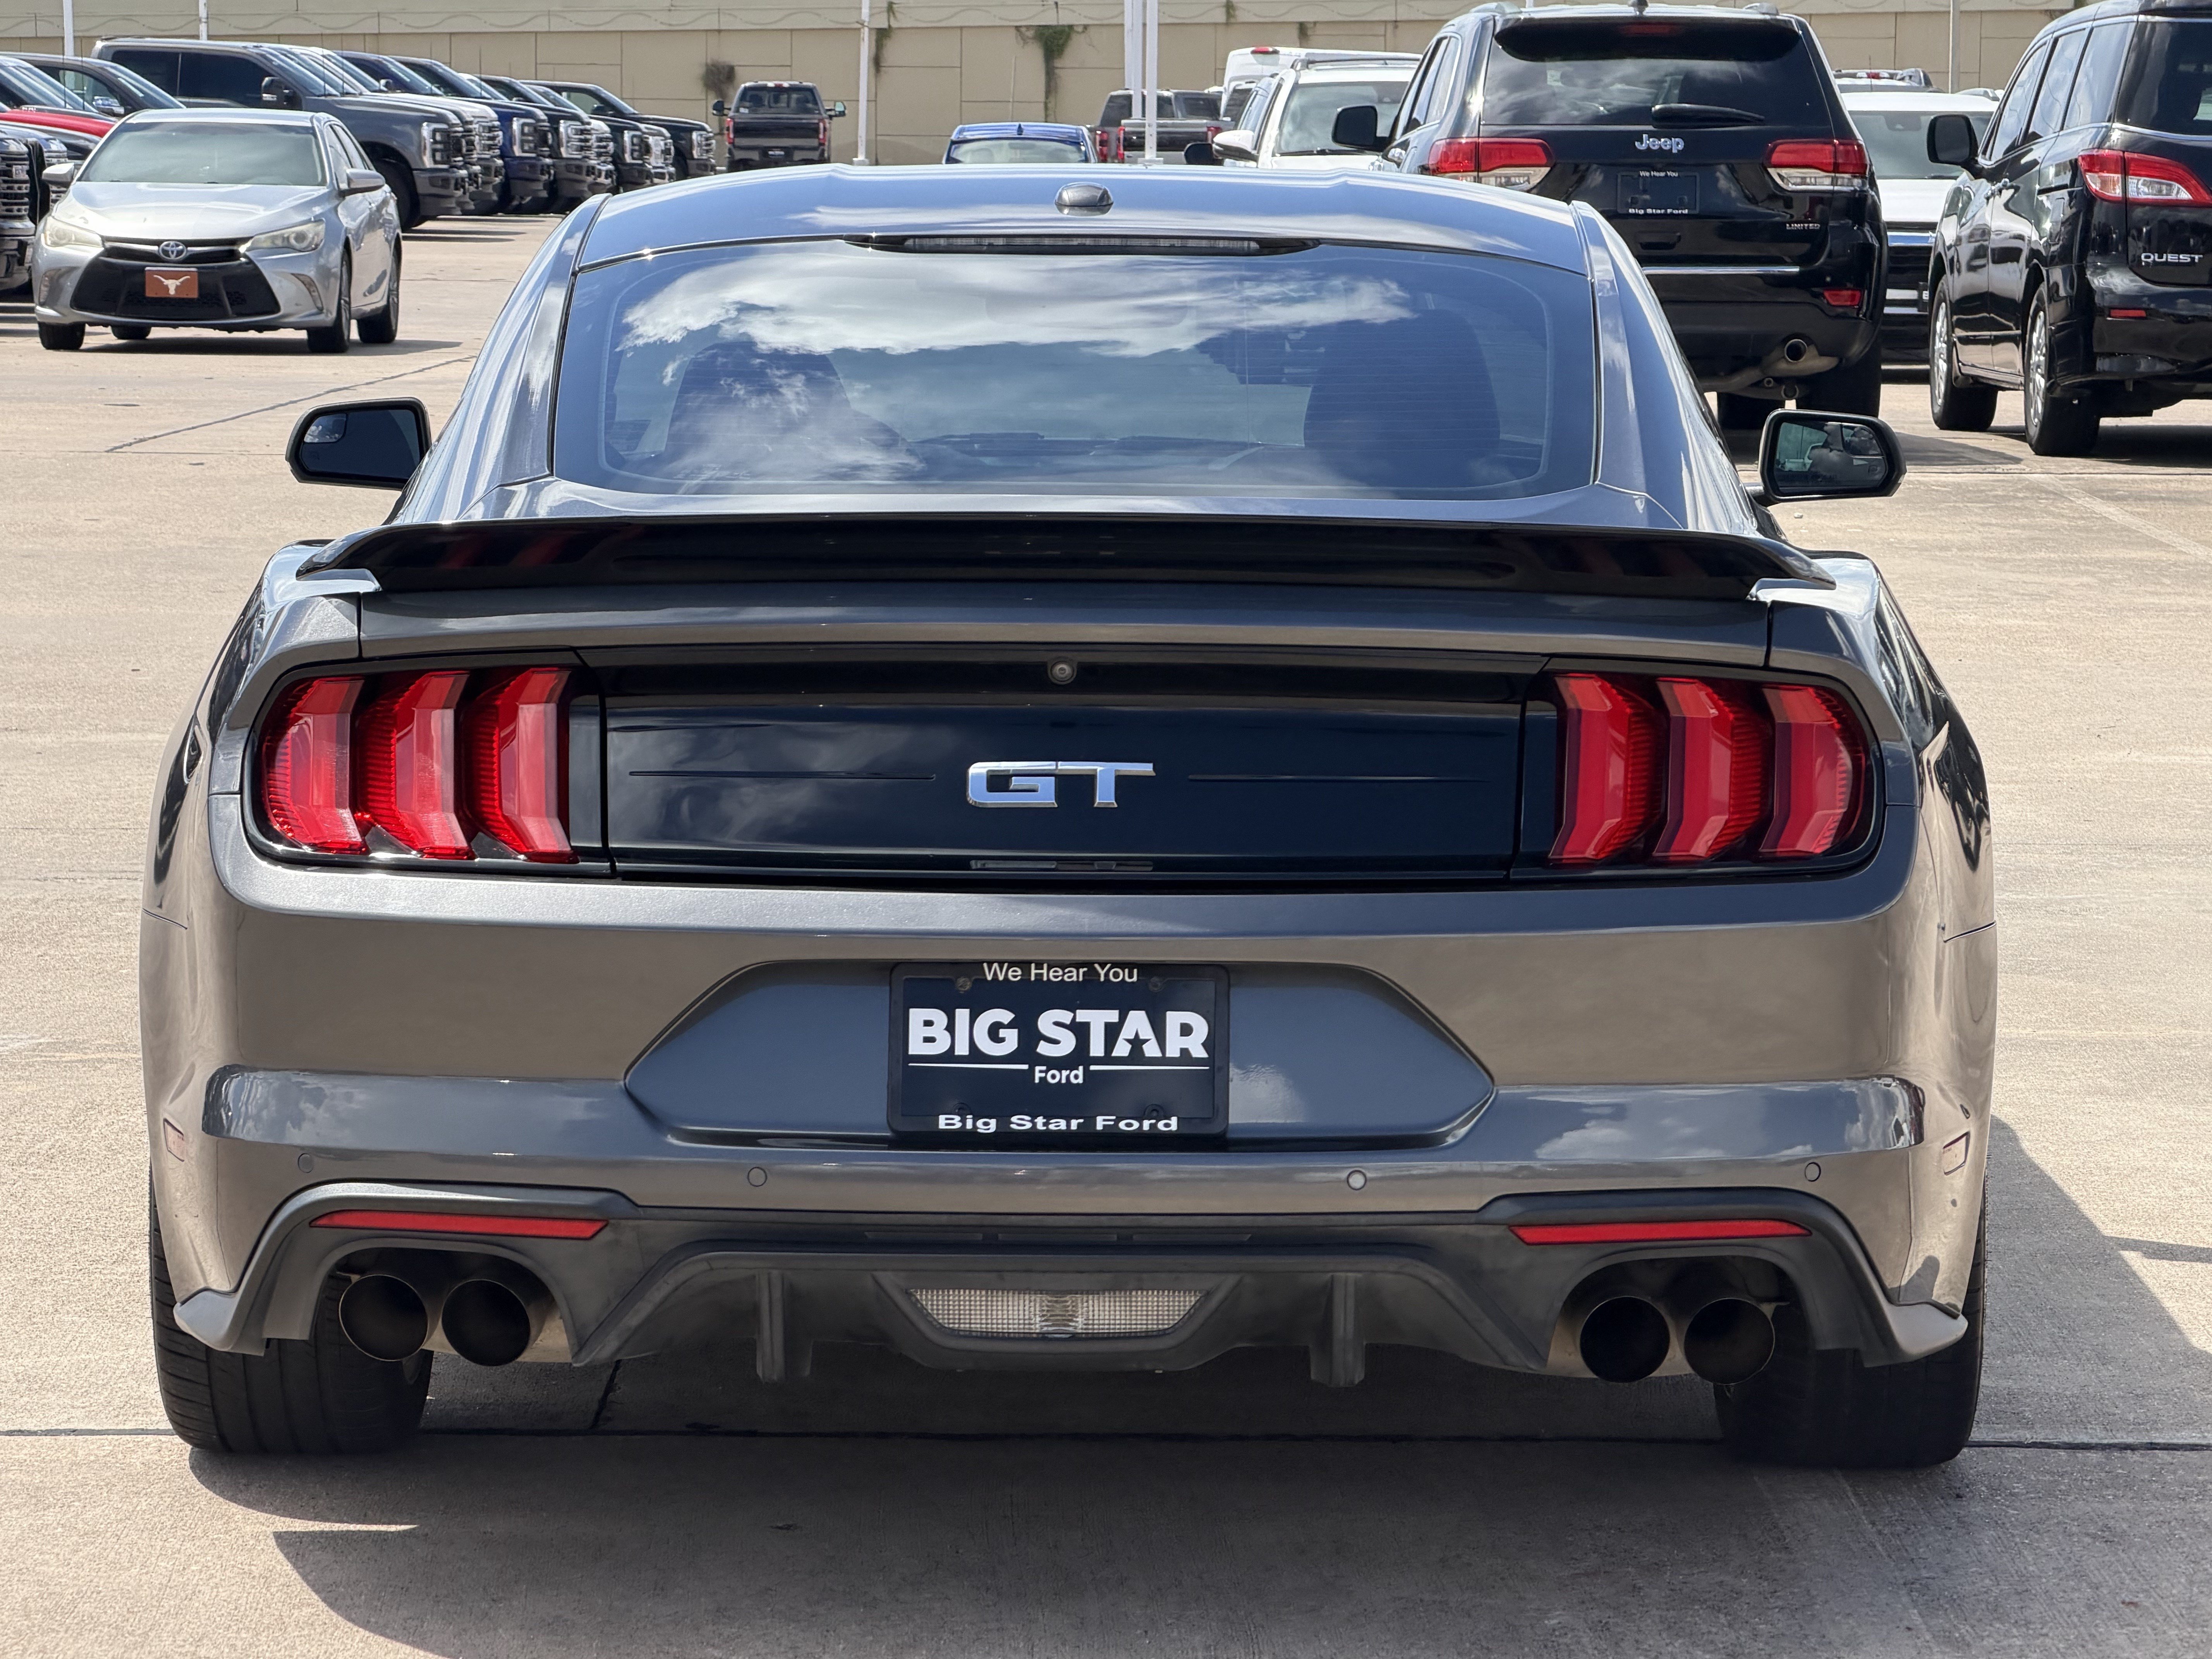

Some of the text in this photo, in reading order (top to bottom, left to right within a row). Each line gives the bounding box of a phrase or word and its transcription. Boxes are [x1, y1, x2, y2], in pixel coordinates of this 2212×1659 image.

[1635, 134, 1685, 153] Jeep
[2141, 252, 2203, 263] QUEST
[967, 761, 1156, 807] GT
[983, 962, 1137, 982] We Hear You
[908, 1008, 1209, 1058] BIG STAR
[1034, 1065, 1084, 1084] Ford
[938, 1114, 1178, 1133] Big Star Ford
